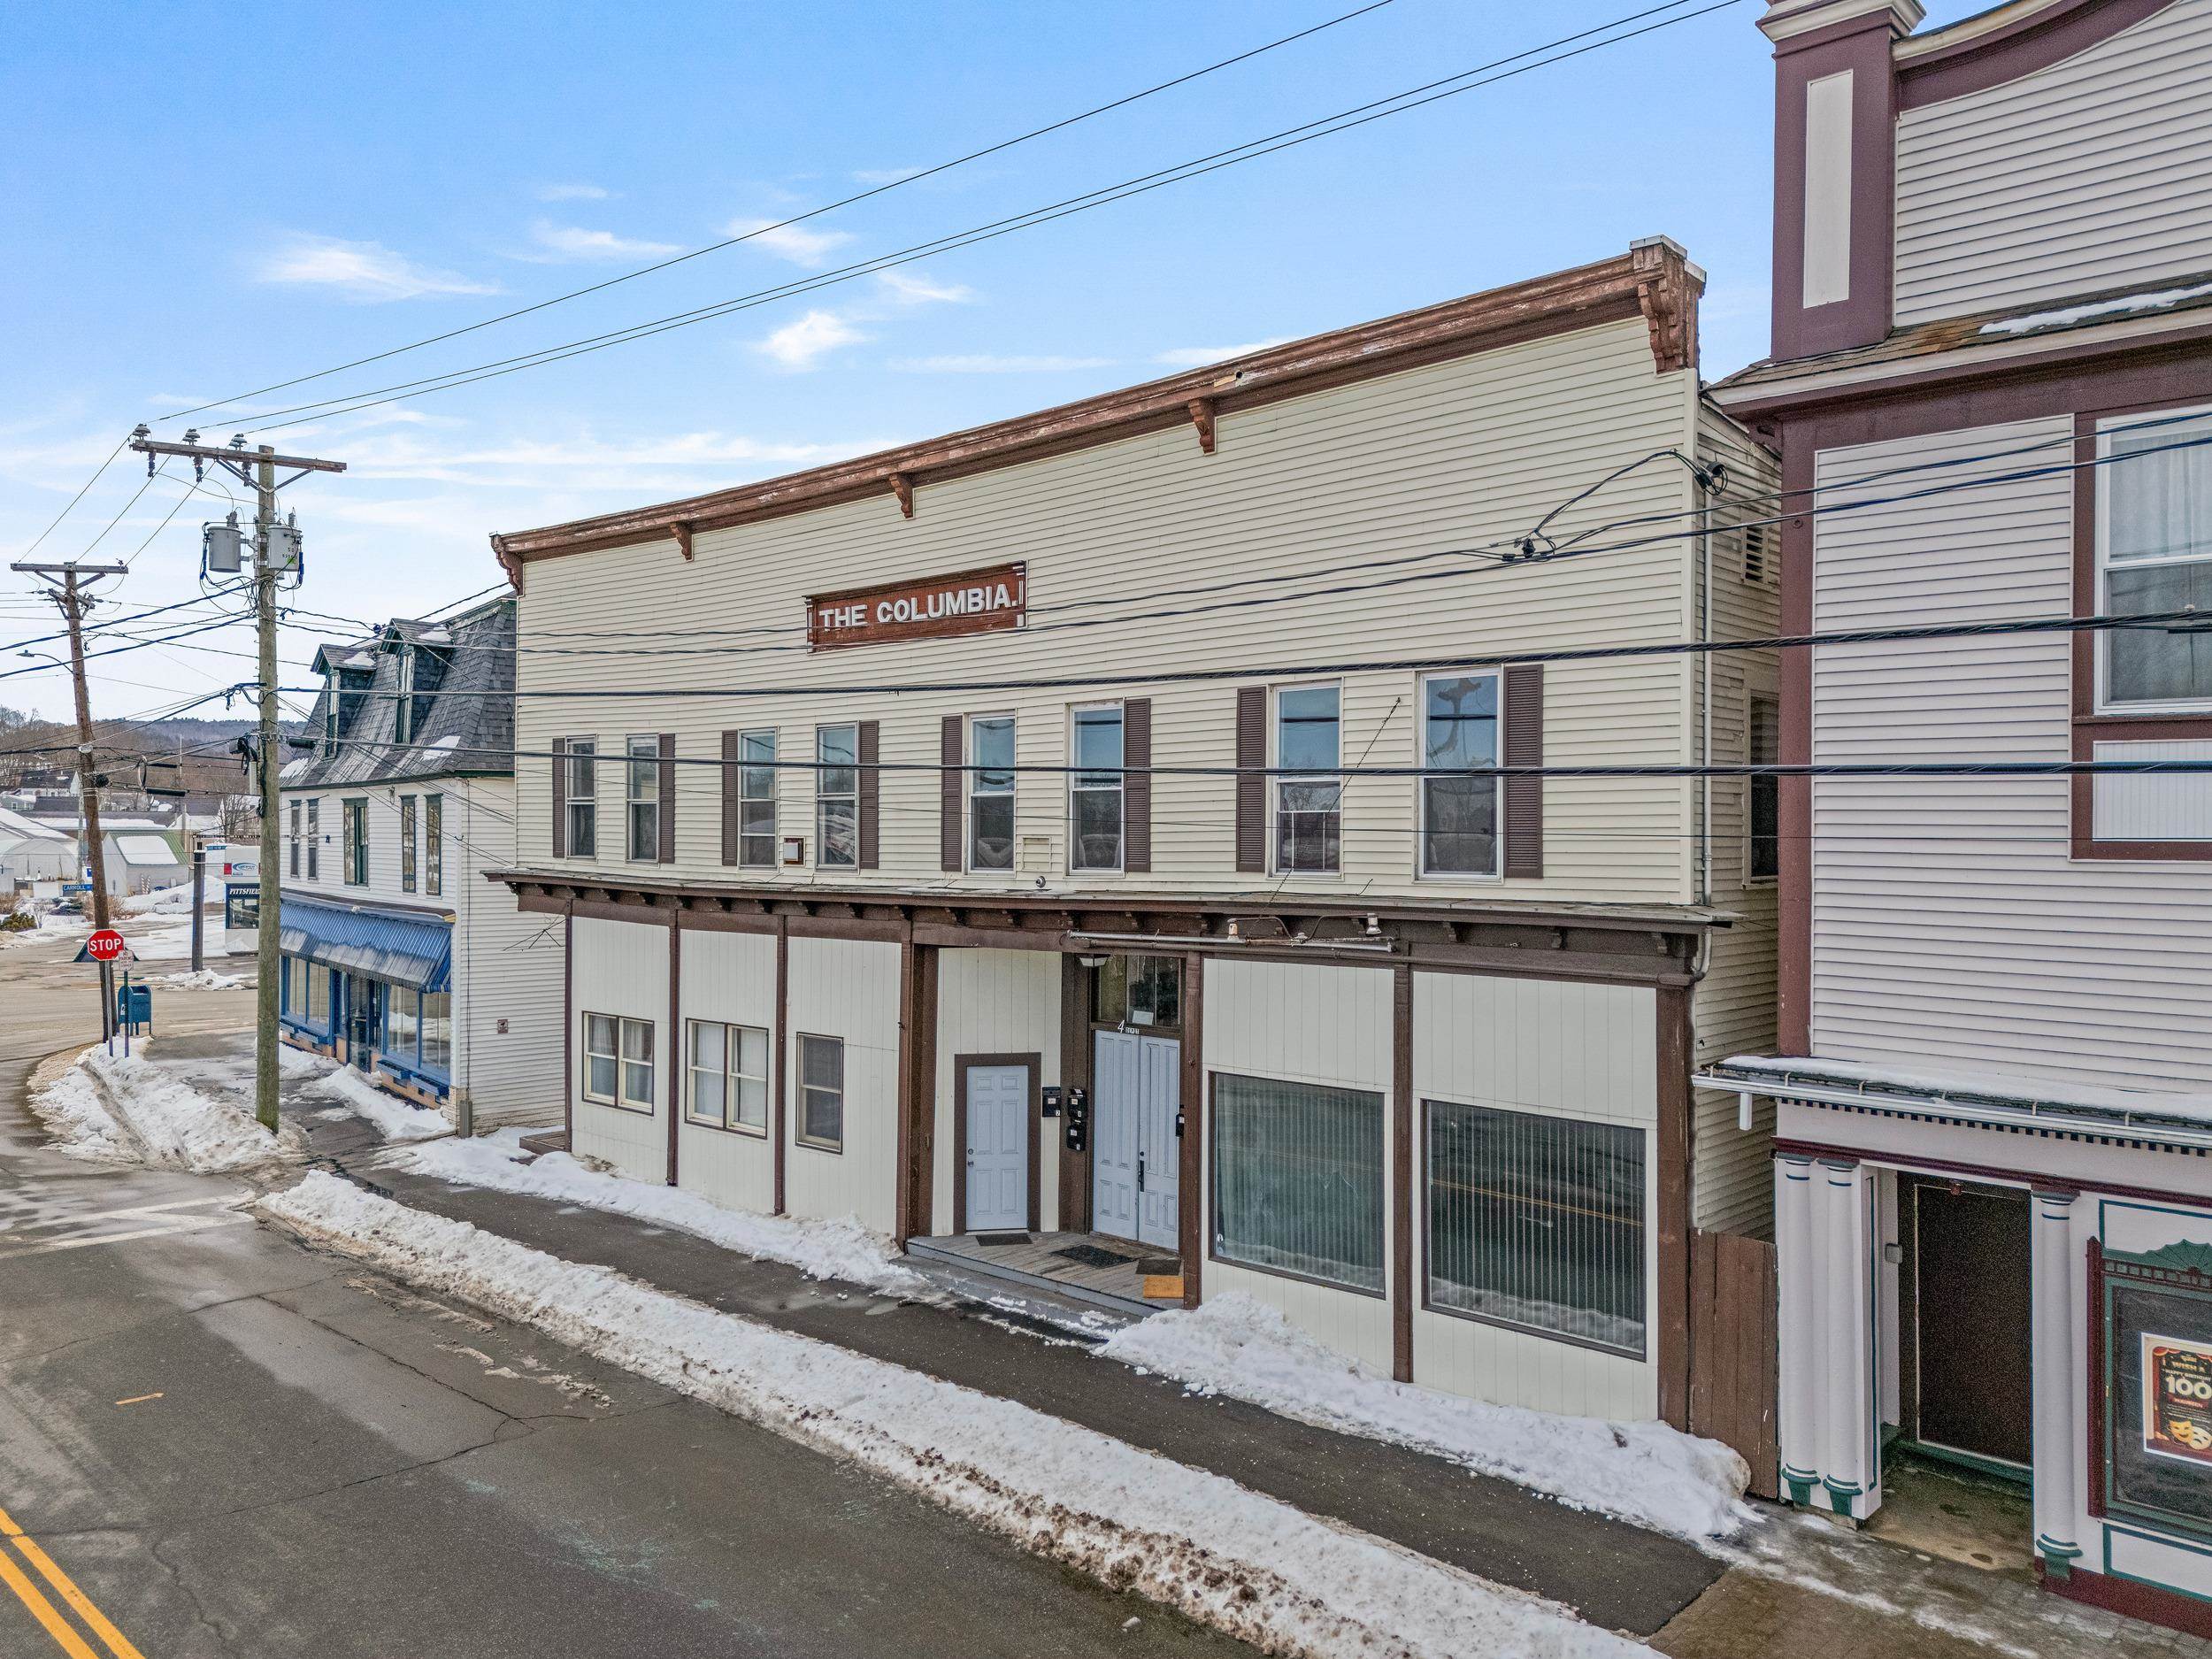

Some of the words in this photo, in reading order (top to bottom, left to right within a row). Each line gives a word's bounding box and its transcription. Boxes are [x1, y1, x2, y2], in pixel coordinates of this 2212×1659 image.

[819, 604, 868, 632] THE
[89, 938, 122, 952] STOP
[1118, 1019, 1125, 1033] 4
[2165, 1375, 2212, 1400] 100
